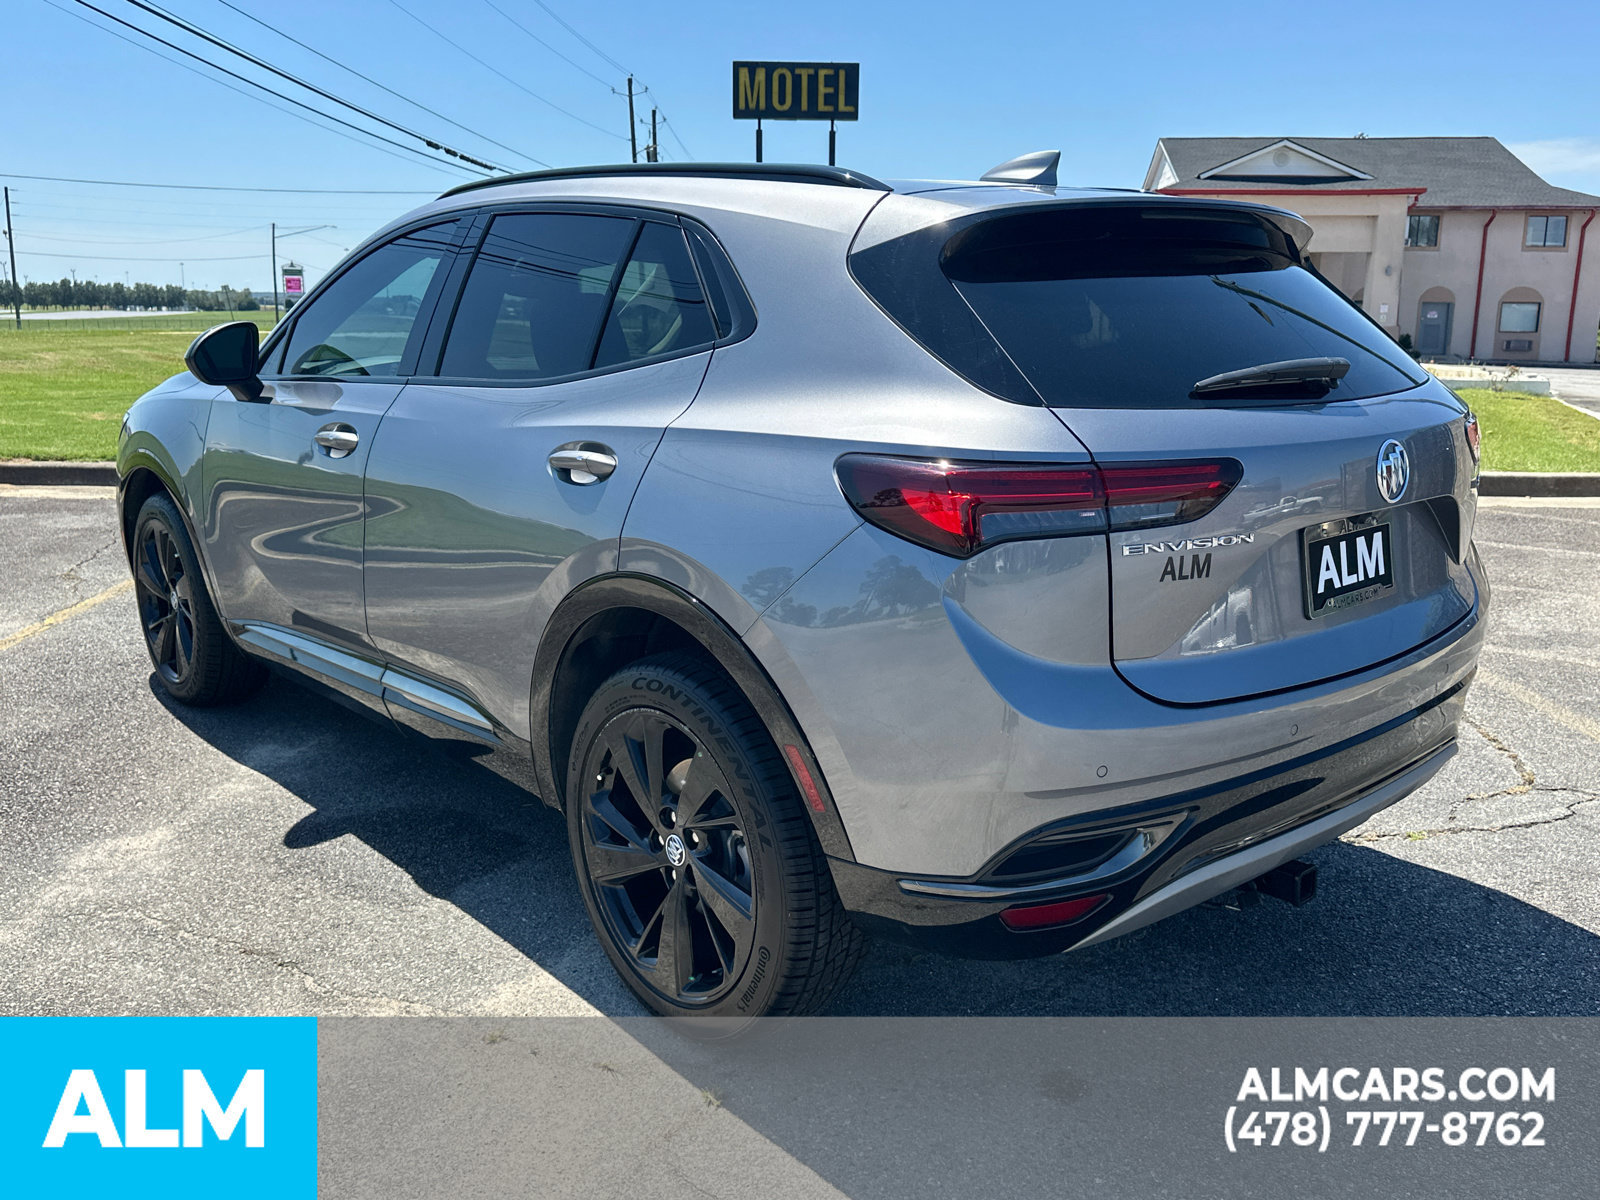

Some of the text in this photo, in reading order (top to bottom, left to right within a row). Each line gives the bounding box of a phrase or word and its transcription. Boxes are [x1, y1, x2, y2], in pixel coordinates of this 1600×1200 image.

[738, 67, 855, 112] MOTEL
[1121, 533, 1255, 556] ENVISION
[1159, 553, 1212, 582] ALM
[1317, 531, 1385, 594] ALM
[631, 676, 773, 853] CONTINENTAL
[741, 945, 771, 1008] Continental
